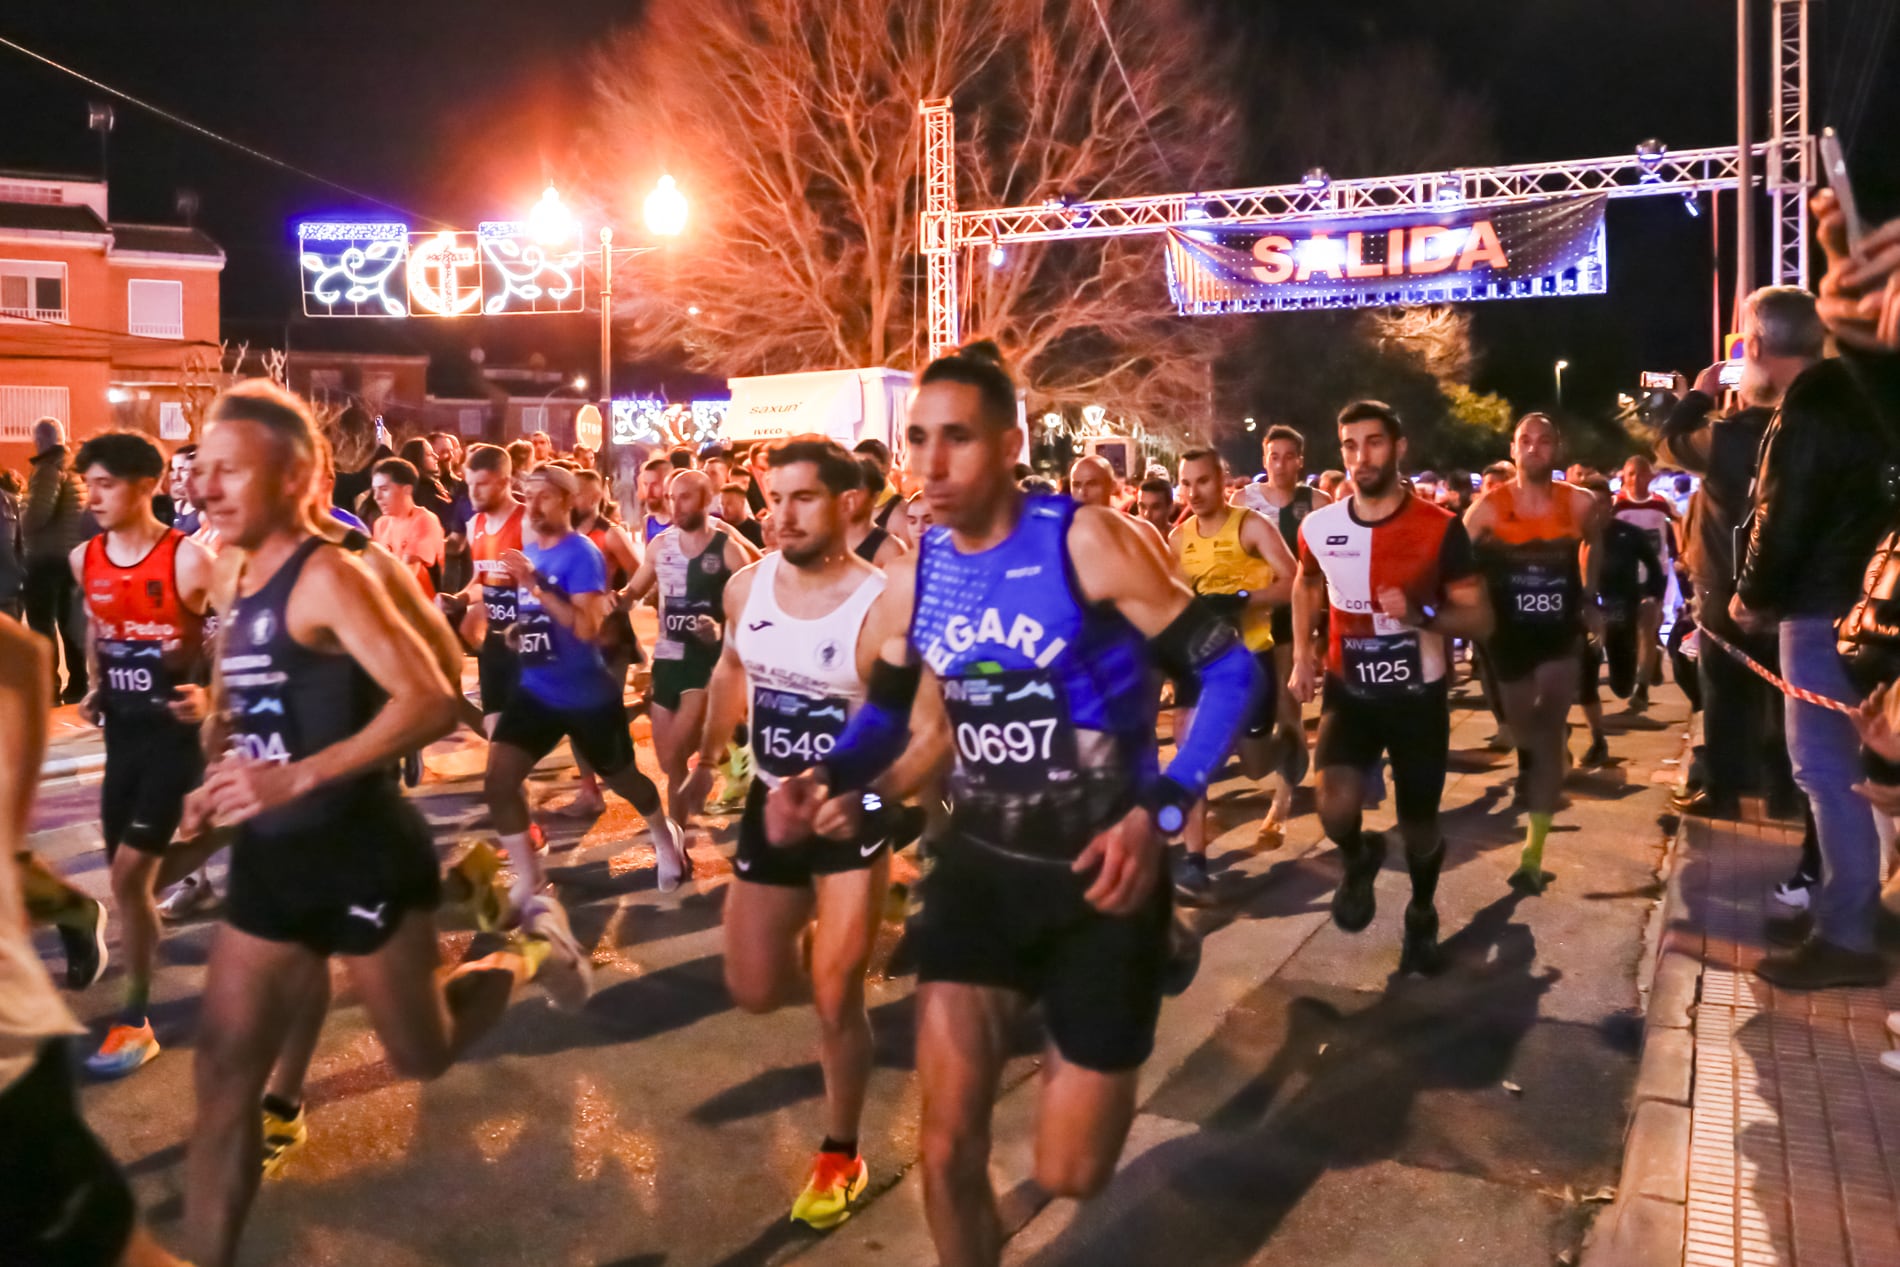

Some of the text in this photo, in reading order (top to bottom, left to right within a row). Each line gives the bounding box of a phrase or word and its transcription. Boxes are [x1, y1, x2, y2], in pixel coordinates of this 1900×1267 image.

[1252, 220, 1509, 283] SALIDA
[582, 422, 602, 436] STOP
[754, 428, 783, 436] IVECO
[485, 603, 517, 621] 364
[1516, 593, 1563, 612] 1283
[667, 614, 697, 631] 073
[107, 667, 152, 691] 1119
[1355, 659, 1411, 683] 1125
[957, 718, 1058, 764] 0697
